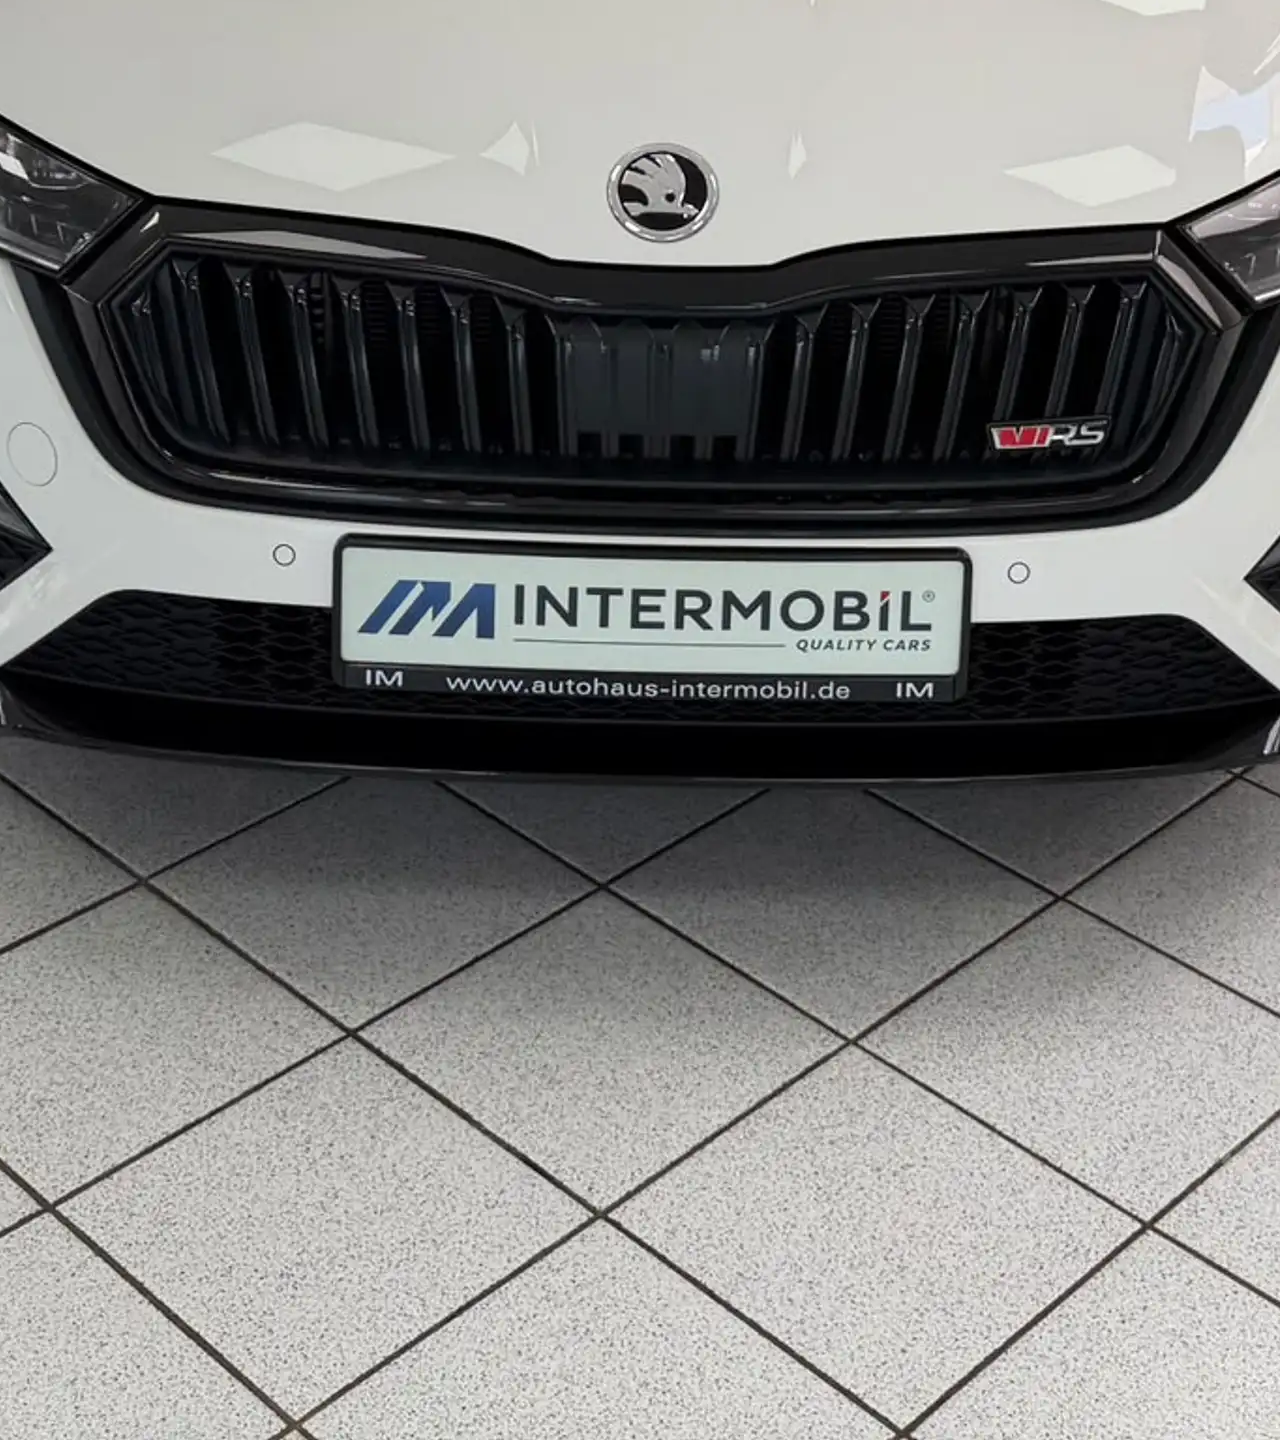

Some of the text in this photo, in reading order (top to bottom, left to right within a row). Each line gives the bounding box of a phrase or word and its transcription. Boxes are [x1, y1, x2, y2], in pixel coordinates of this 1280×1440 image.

[796, 638, 932, 652] QUALITY CARS
[365, 669, 934, 700] IM www.autohaus-intermobil.de IM
